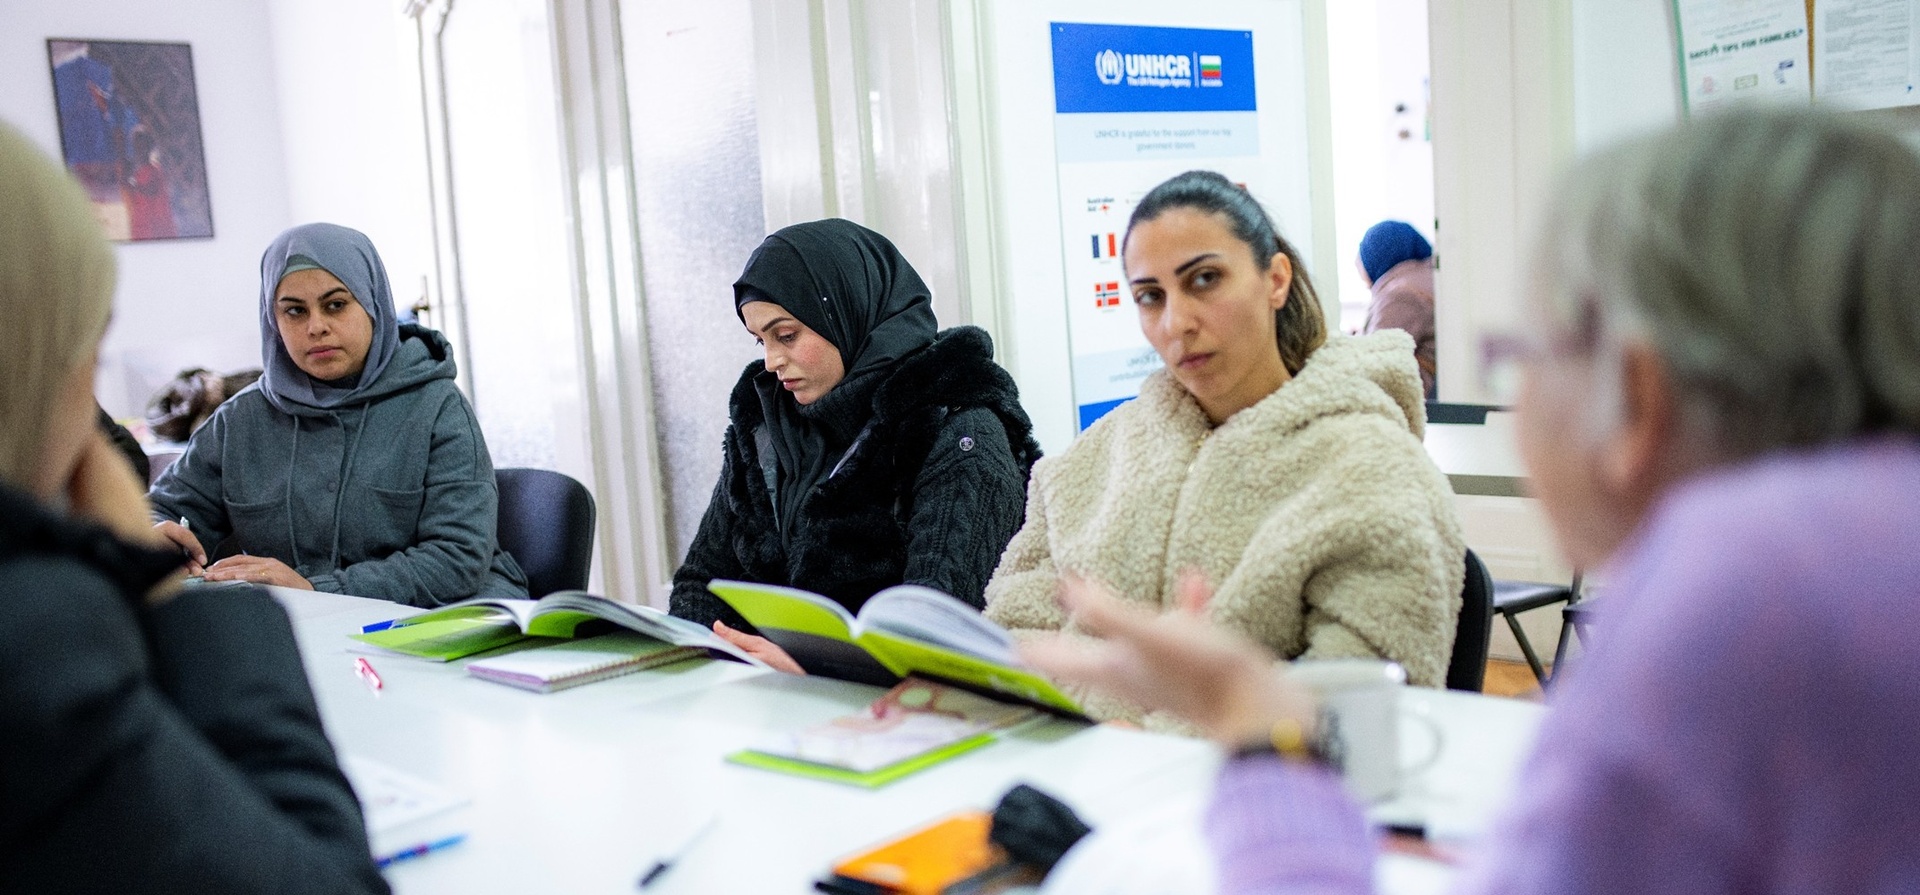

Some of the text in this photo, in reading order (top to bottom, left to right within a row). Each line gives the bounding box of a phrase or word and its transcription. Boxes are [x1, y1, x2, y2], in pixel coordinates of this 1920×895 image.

[1722, 43, 1739, 52] TIPS
[1741, 39, 1757, 48] FOR
[1125, 54, 1191, 77] UNHCR
[1127, 77, 1138, 86] The
[1095, 129, 1119, 138] UNHCR
